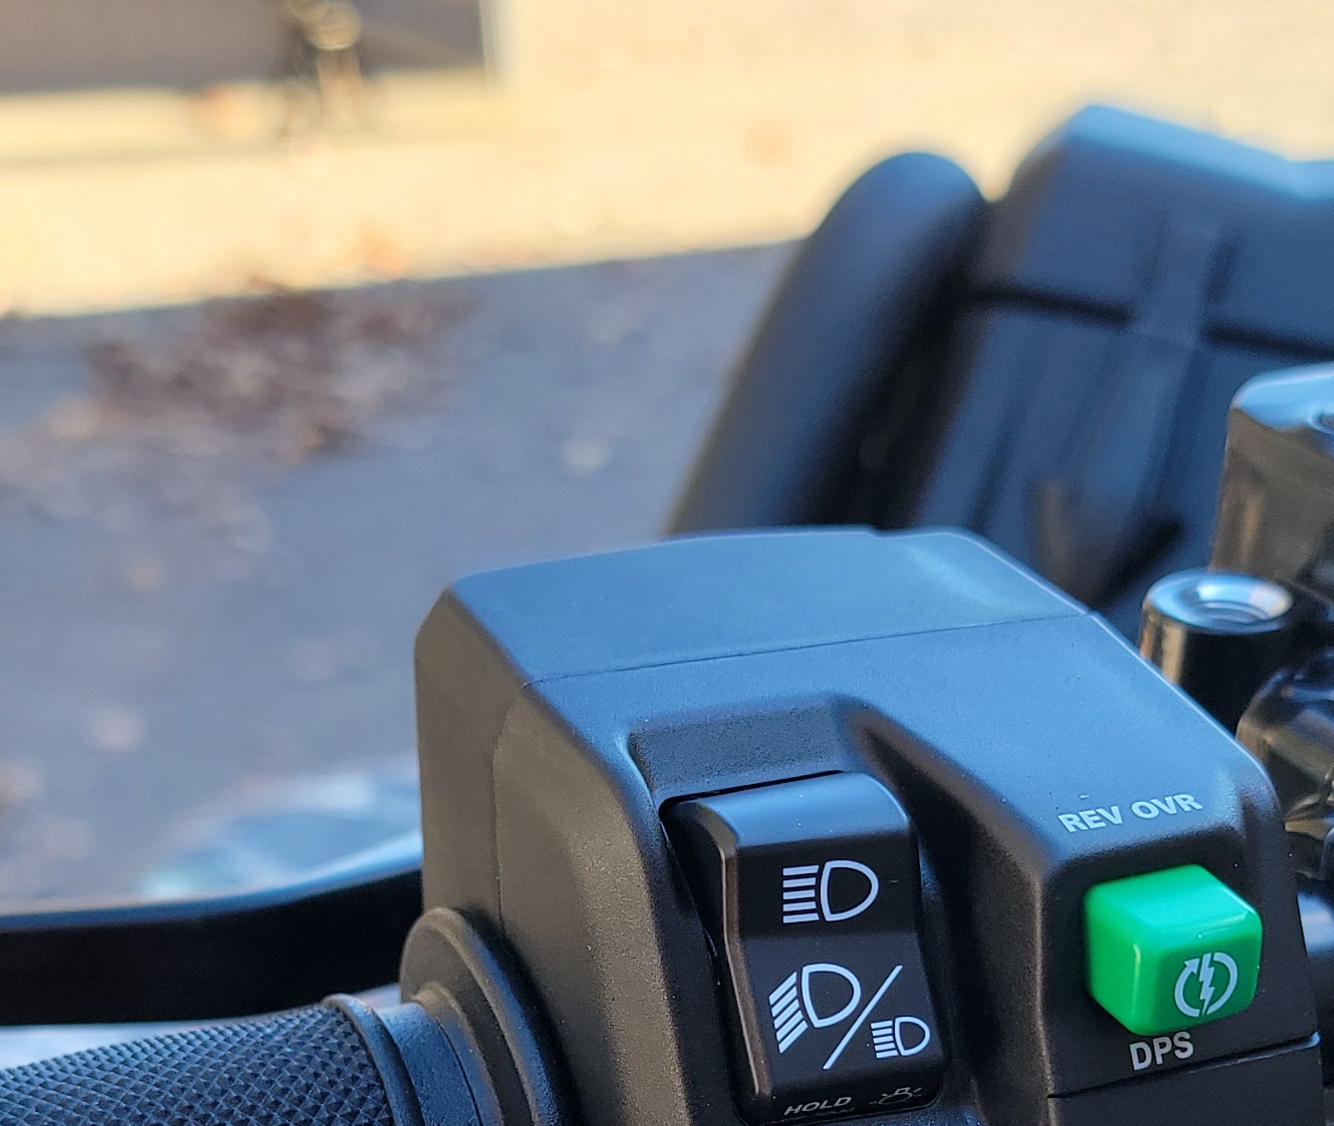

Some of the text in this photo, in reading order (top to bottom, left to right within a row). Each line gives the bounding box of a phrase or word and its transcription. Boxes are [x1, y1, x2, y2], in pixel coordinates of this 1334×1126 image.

[1058, 793, 1203, 833] REV OVR
[1129, 1031, 1194, 1071] DPS
[783, 1096, 852, 1116] HOLD
